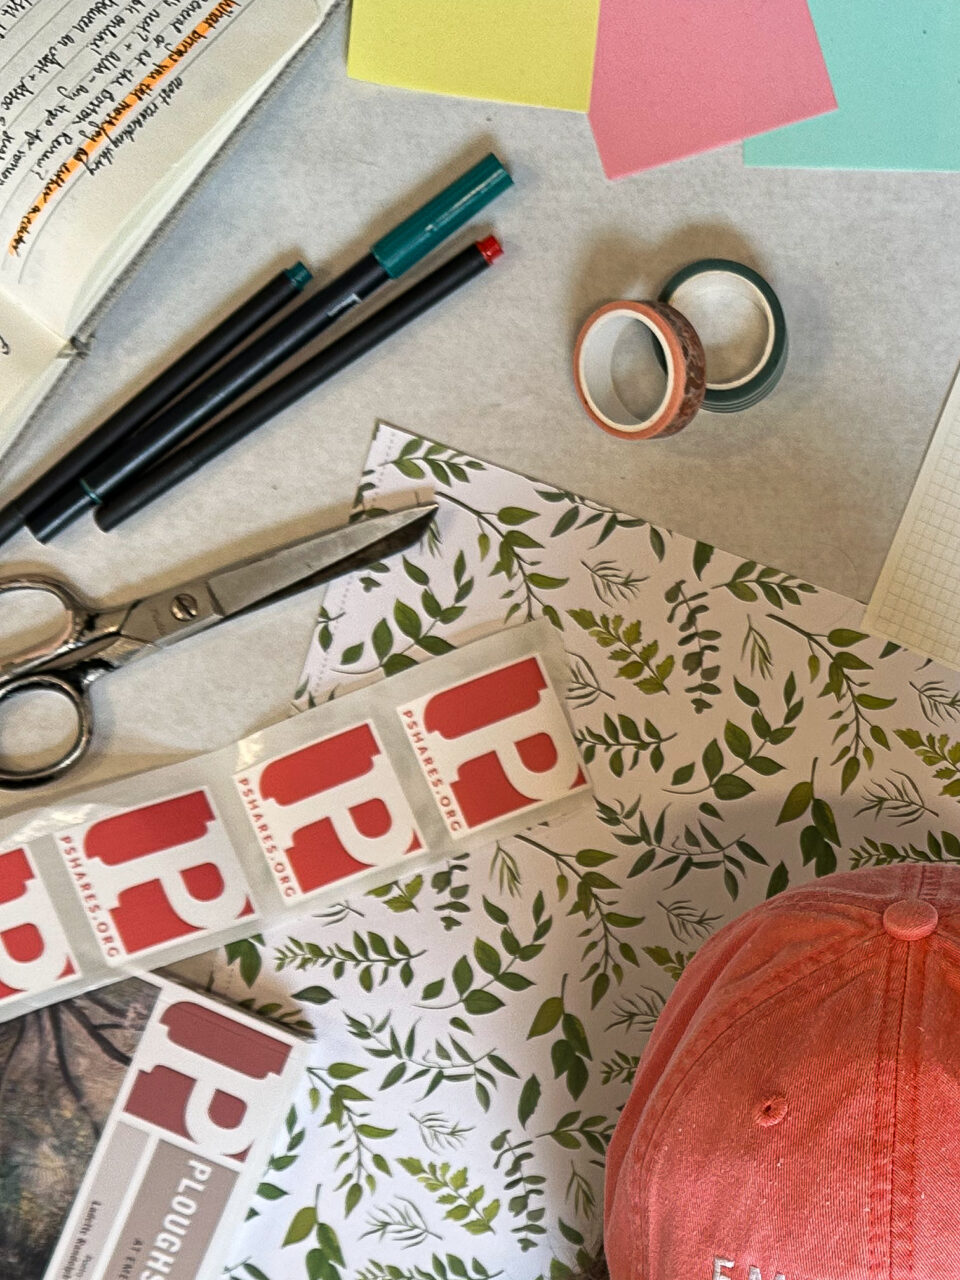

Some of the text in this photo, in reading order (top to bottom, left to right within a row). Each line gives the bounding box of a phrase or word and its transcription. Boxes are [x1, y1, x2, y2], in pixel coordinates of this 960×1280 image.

[205, 0, 241, 29] What
[57, 34, 75, 46] an
[153, 35, 165, 48] or
[165, 30, 207, 63] brings
[93, 51, 121, 74] also
[134, 49, 151, 66] at
[110, 69, 134, 86] the
[147, 62, 168, 80] you
[131, 83, 153, 101] the
[154, 76, 183, 105] most
[45, 105, 70, 126] tips
[72, 88, 115, 125] Boston
[103, 100, 131, 126] most
[401, 709, 460, 834] PSHARES.ORG
[237, 776, 299, 900] PSHARES.ORG
[58, 834, 120, 959] PSHARES.ORG
[128, 1236, 143, 1254] AT
